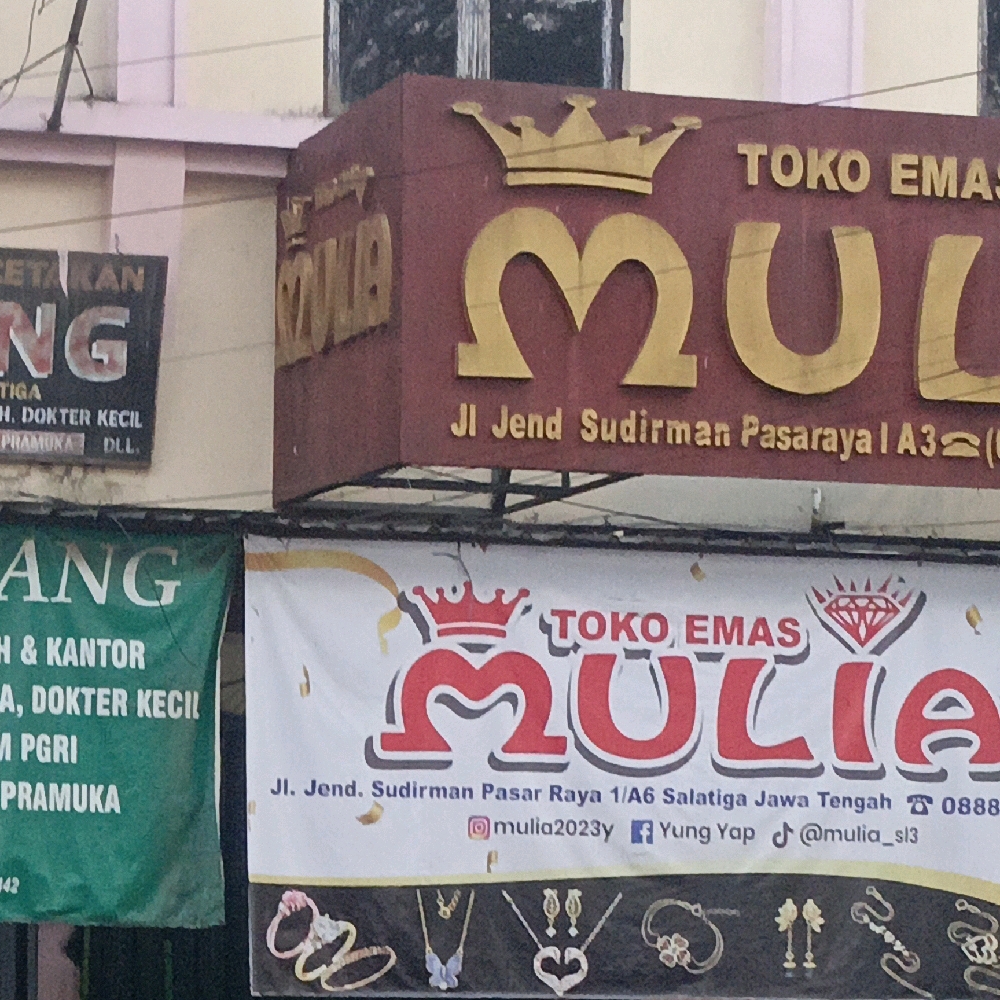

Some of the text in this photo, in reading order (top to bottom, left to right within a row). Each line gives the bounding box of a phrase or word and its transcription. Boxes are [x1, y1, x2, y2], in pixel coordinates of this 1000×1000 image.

[737, 144, 1000, 201] TOKO EMA
[21, 405, 92, 426] DOKTER
[97, 409, 143, 429] KECIL
[491, 404, 562, 440] Jend
[580, 407, 731, 447] Sudirman
[741, 414, 872, 461] Pasaraya
[897, 422, 937, 457] A3
[550, 608, 801, 648] TOKO EMAS
[20, 634, 38, 665] &
[46, 636, 146, 671] KANTOR
[31, 684, 128, 717] DOKTER
[136, 688, 200, 719] KECIL
[381, 648, 1000, 767] MULIA
[20, 733, 78, 764] PGRI
[0, 782, 121, 814] PRAMUKA
[303, 778, 364, 798] Jend.
[371, 779, 474, 801] Sudirman
[482, 783, 543, 802] Pasar
[549, 784, 602, 808] Raya
[610, 786, 656, 805] 1/A6
[662, 786, 748, 811] Salatiga
[755, 790, 810, 809] Jawa
[816, 791, 893, 815] Tengah
[493, 817, 615, 844] mulia2023y
[659, 820, 756, 847] Yung Yap
